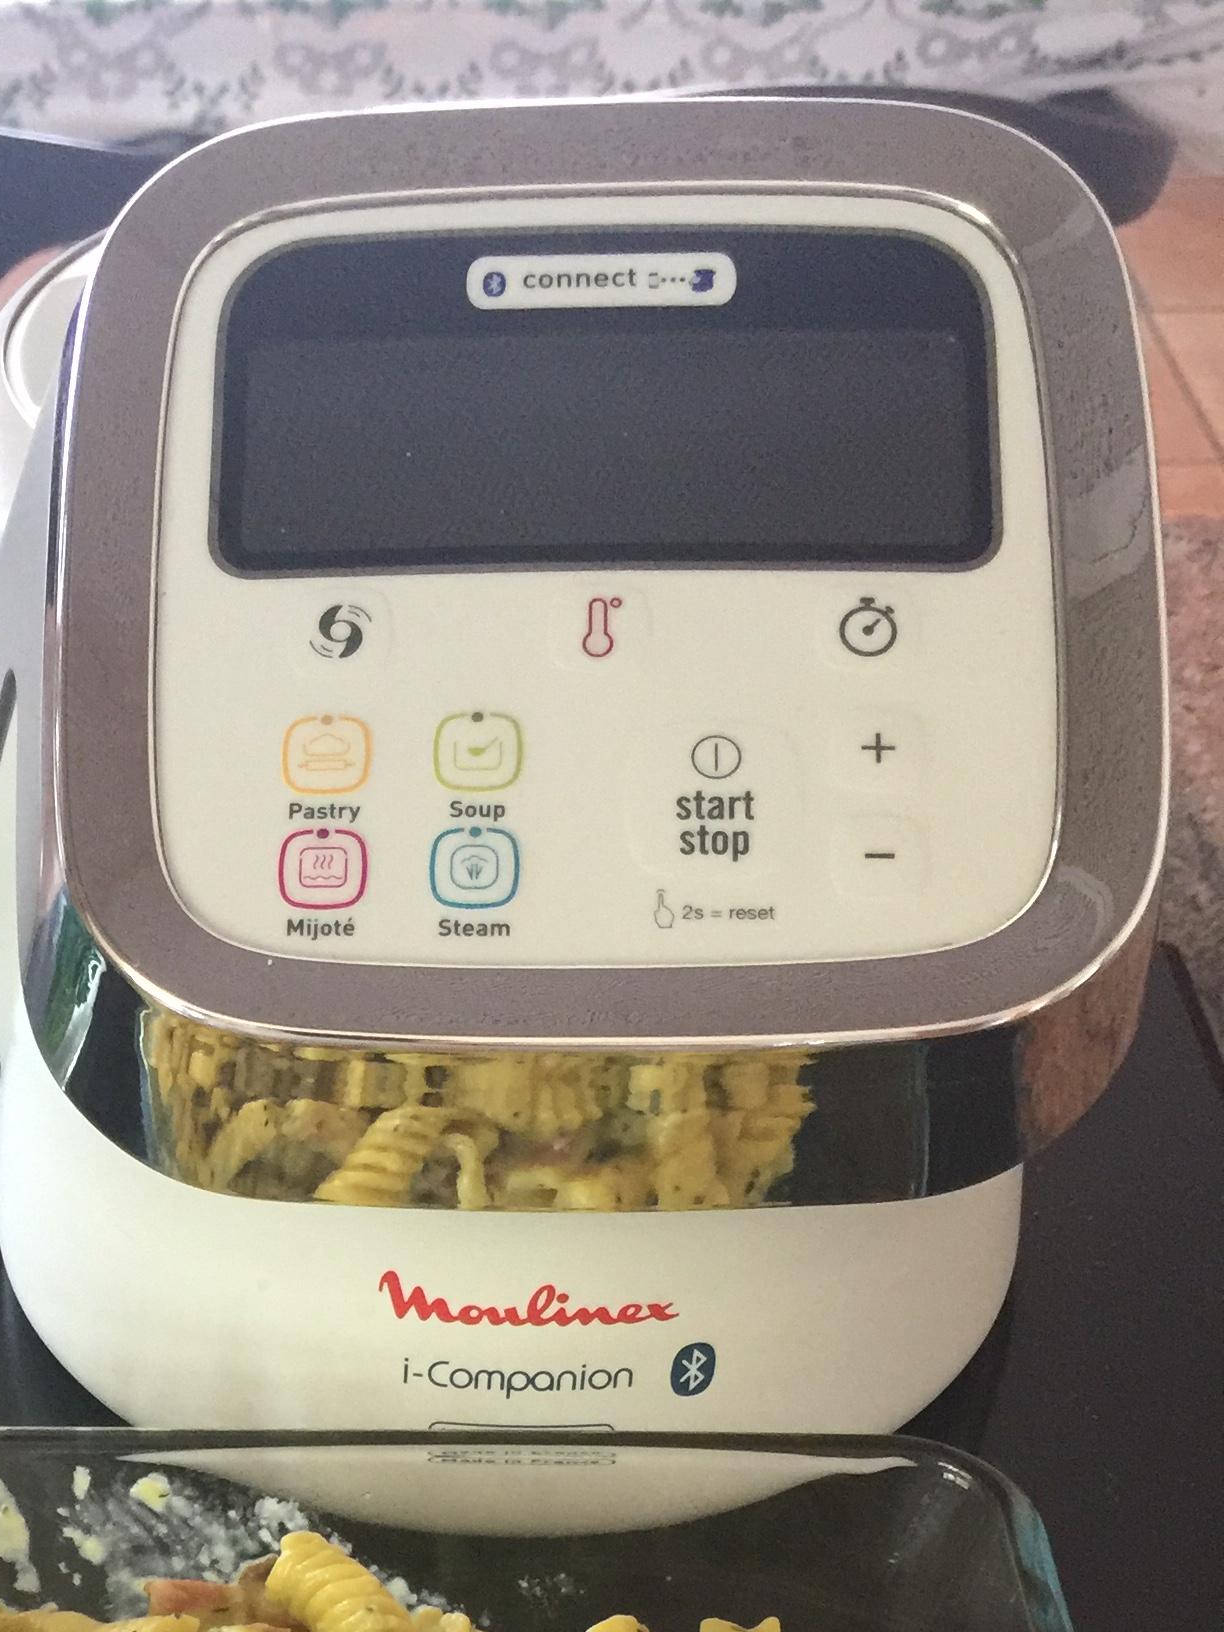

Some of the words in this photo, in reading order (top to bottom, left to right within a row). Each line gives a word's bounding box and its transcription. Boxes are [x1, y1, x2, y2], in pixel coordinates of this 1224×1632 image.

[522, 266, 638, 290] connect
[288, 802, 361, 823] Pastry
[449, 800, 506, 823] Soup
[675, 790, 755, 823] start
[679, 824, 751, 862] stop
[682, 904, 705, 921] 2s
[728, 905, 775, 921] reset
[285, 917, 355, 941] Mijoté
[438, 918, 511, 938] Steam
[378, 1270, 680, 1328] Moulinex
[402, 1356, 634, 1400] i-Companion
